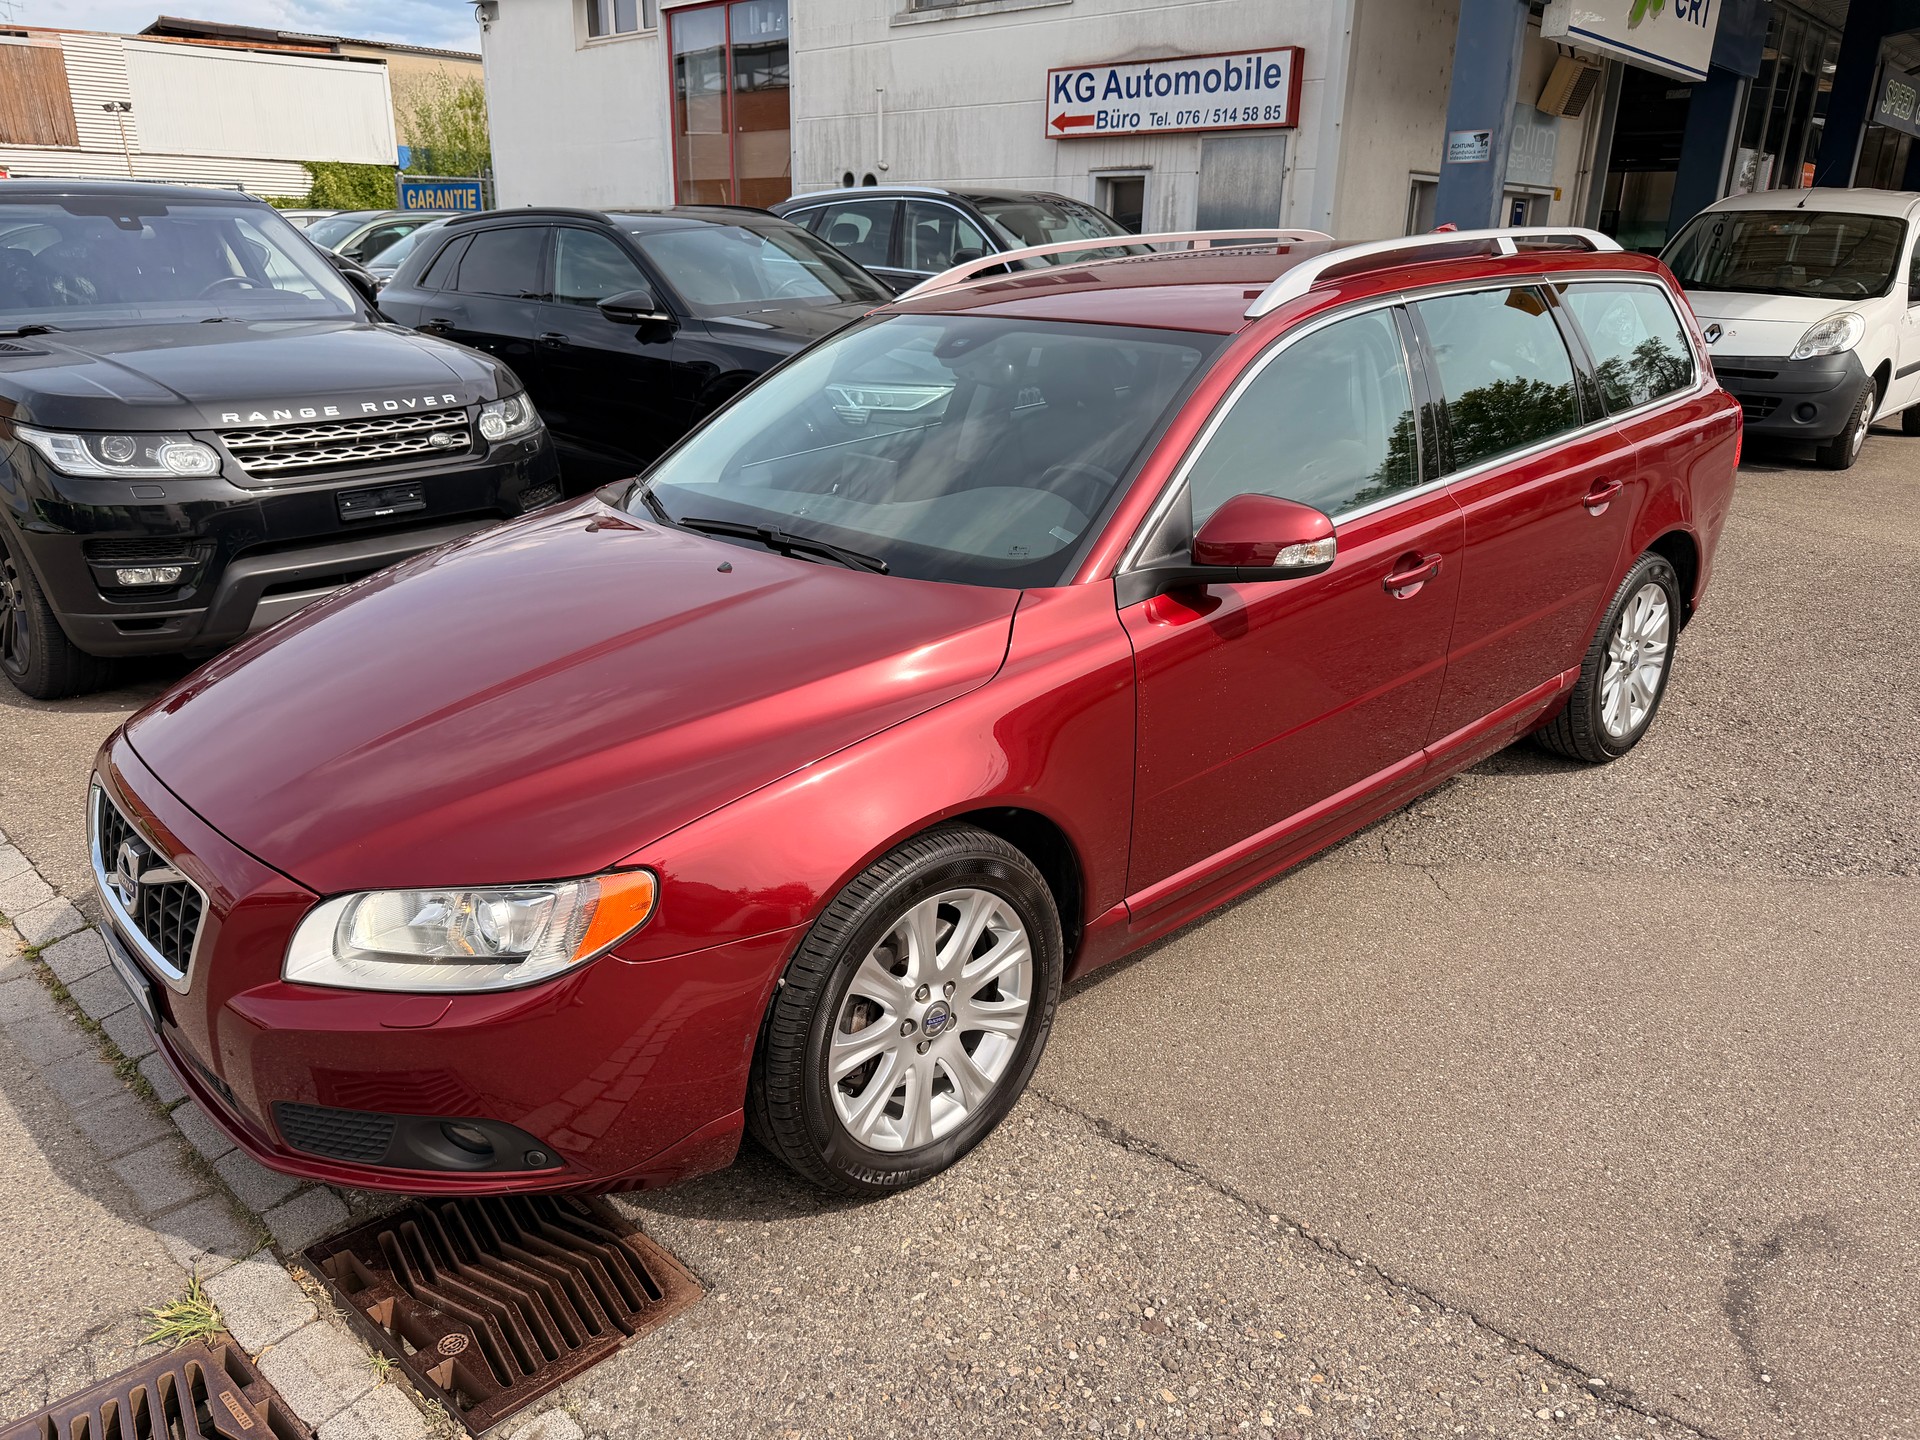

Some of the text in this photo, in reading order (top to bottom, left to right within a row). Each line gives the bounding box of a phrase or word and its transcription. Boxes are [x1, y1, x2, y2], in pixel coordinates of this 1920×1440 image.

[1053, 56, 1282, 105] KG Automobile
[1881, 78, 1917, 121] SPEED
[1096, 105, 1281, 130] Büro Tel. 076 / 514 58 85
[1509, 152, 1553, 173] service
[407, 189, 477, 209] GARANTIE
[222, 394, 458, 423] RANGE ROVER
[844, 1162, 934, 1186] SEMPERIT
